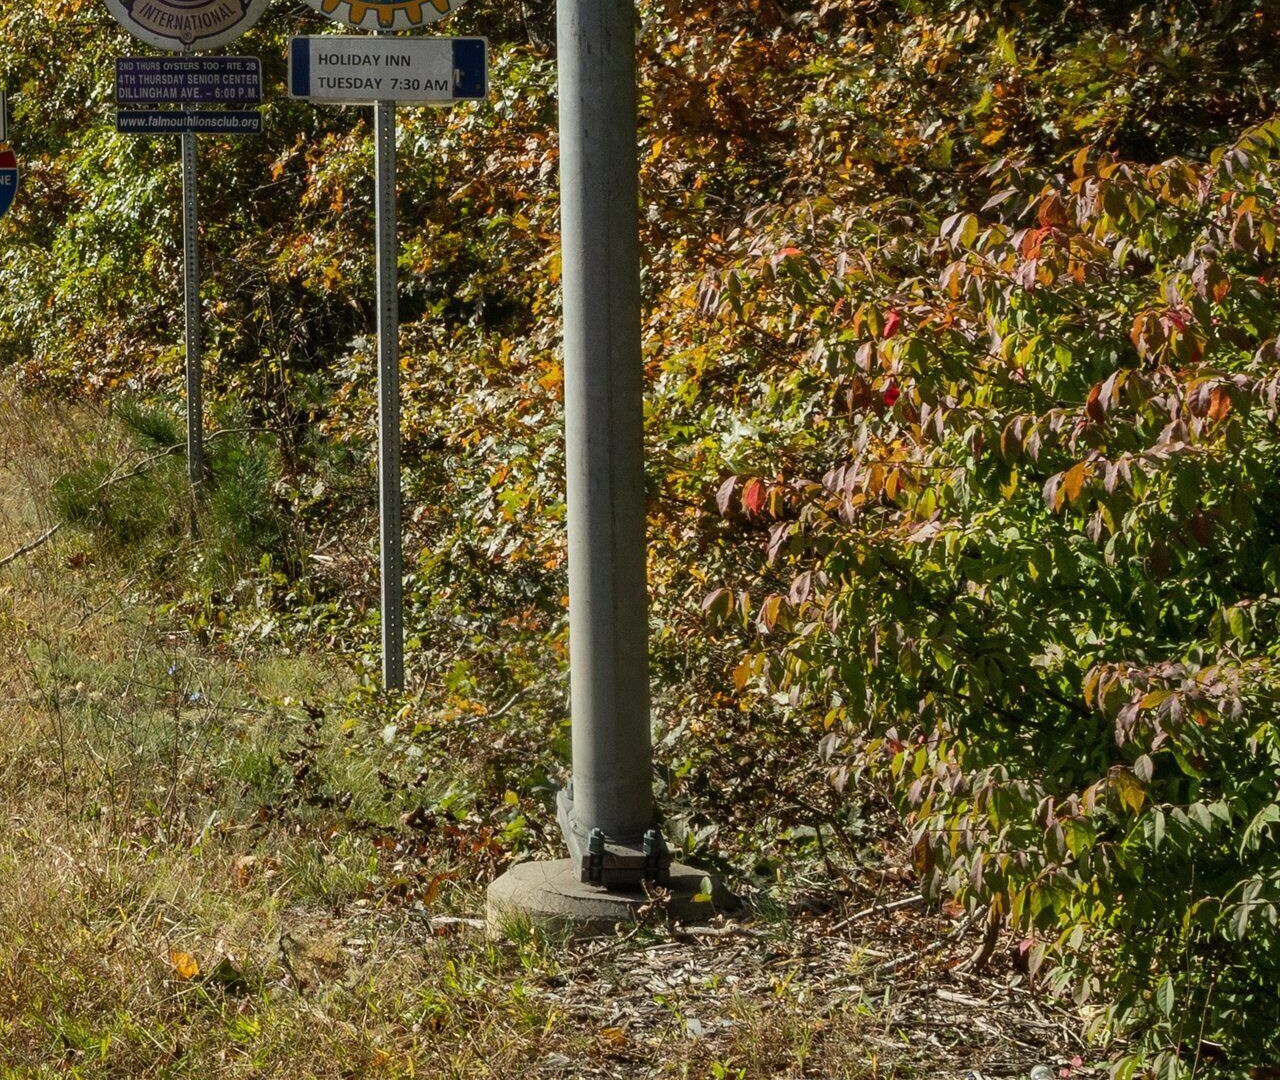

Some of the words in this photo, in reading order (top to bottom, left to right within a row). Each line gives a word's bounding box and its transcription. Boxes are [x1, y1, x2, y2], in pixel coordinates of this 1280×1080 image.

[139, 2, 237, 32] INTERNATIONAL
[118, 62, 134, 71] 2ND
[136, 62, 161, 71] THURS
[163, 62, 199, 71] OYSTERS
[203, 62, 219, 71] TOO
[245, 62, 257, 71] 28
[318, 53, 381, 67] HOLIDAY
[385, 55, 411, 67] INN
[118, 74, 135, 84] 4TH
[138, 74, 184, 85] THURSDAY
[187, 74, 220, 84] SENIOR
[223, 74, 258, 84] CENTER
[317, 77, 383, 90] TUESDAY
[390, 78, 420, 91] 7:30
[423, 79, 449, 91] AM
[118, 87, 178, 99] DILLINGHAM
[181, 87, 203, 98] AVE.
[215, 87, 235, 98] 6:00
[238, 87, 258, 98] P.M.
[120, 115, 259, 129] www.falmouthlionsclub.org
